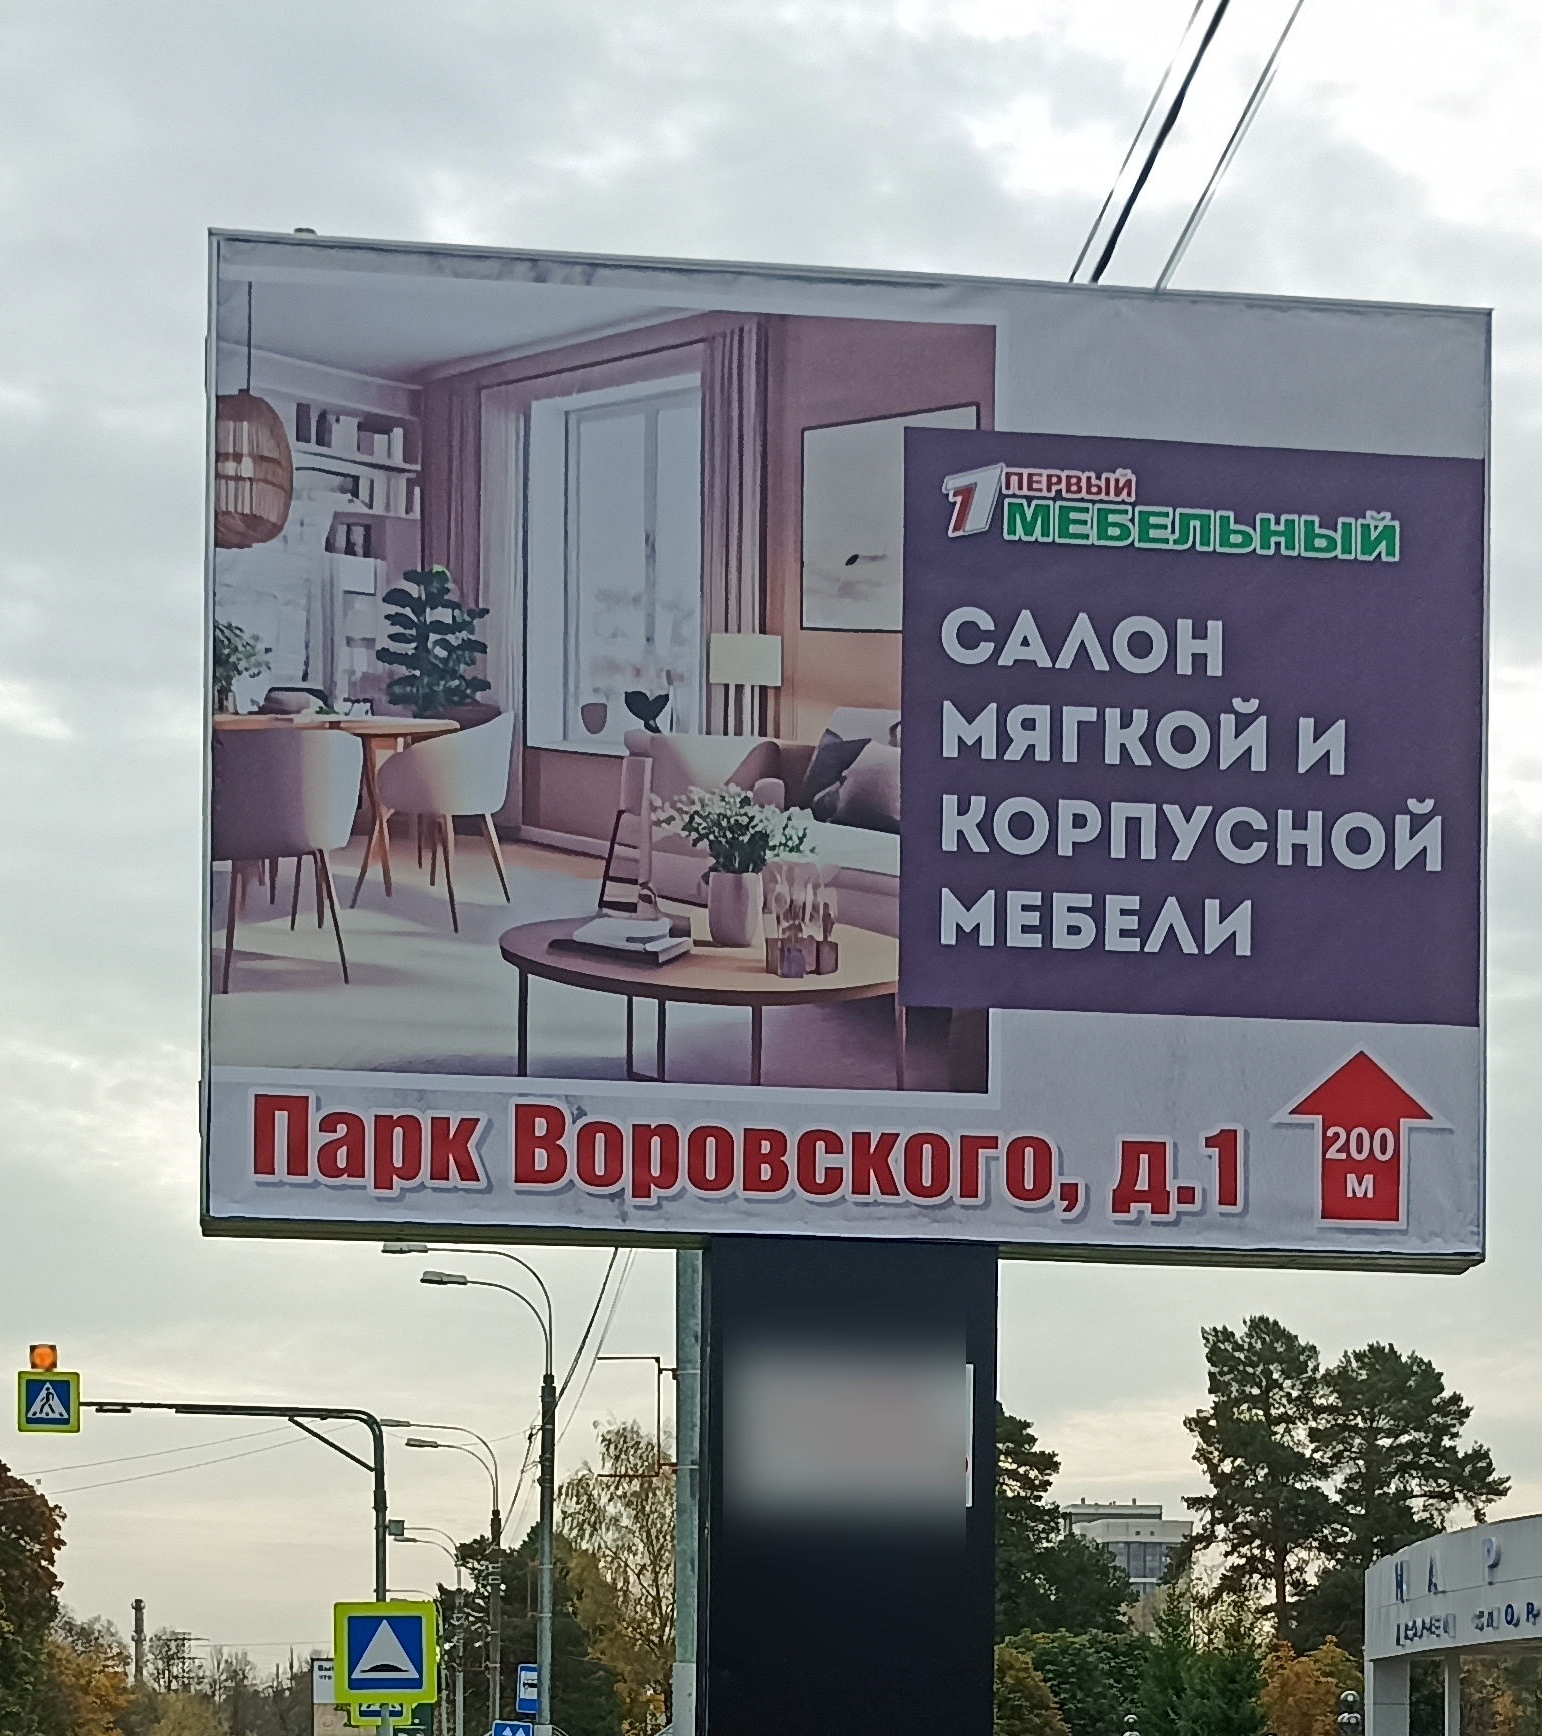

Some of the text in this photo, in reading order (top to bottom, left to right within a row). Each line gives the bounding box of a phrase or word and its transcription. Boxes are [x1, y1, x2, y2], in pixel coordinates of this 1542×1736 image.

[1004, 469, 1136, 501] ПЕРВЫЙ
[1004, 501, 1400, 561] МЕБЕЛЬНЫЙ
[941, 607, 1224, 677] САЛОН
[942, 698, 1346, 776] МЯГКОЙ И
[941, 794, 1442, 872] КОРПУСНОЙ
[940, 888, 1252, 957] МЕБЕЛИ
[253, 1093, 1239, 1215] Парк Воровского, д.1
[1325, 1126, 1396, 1161] 200
